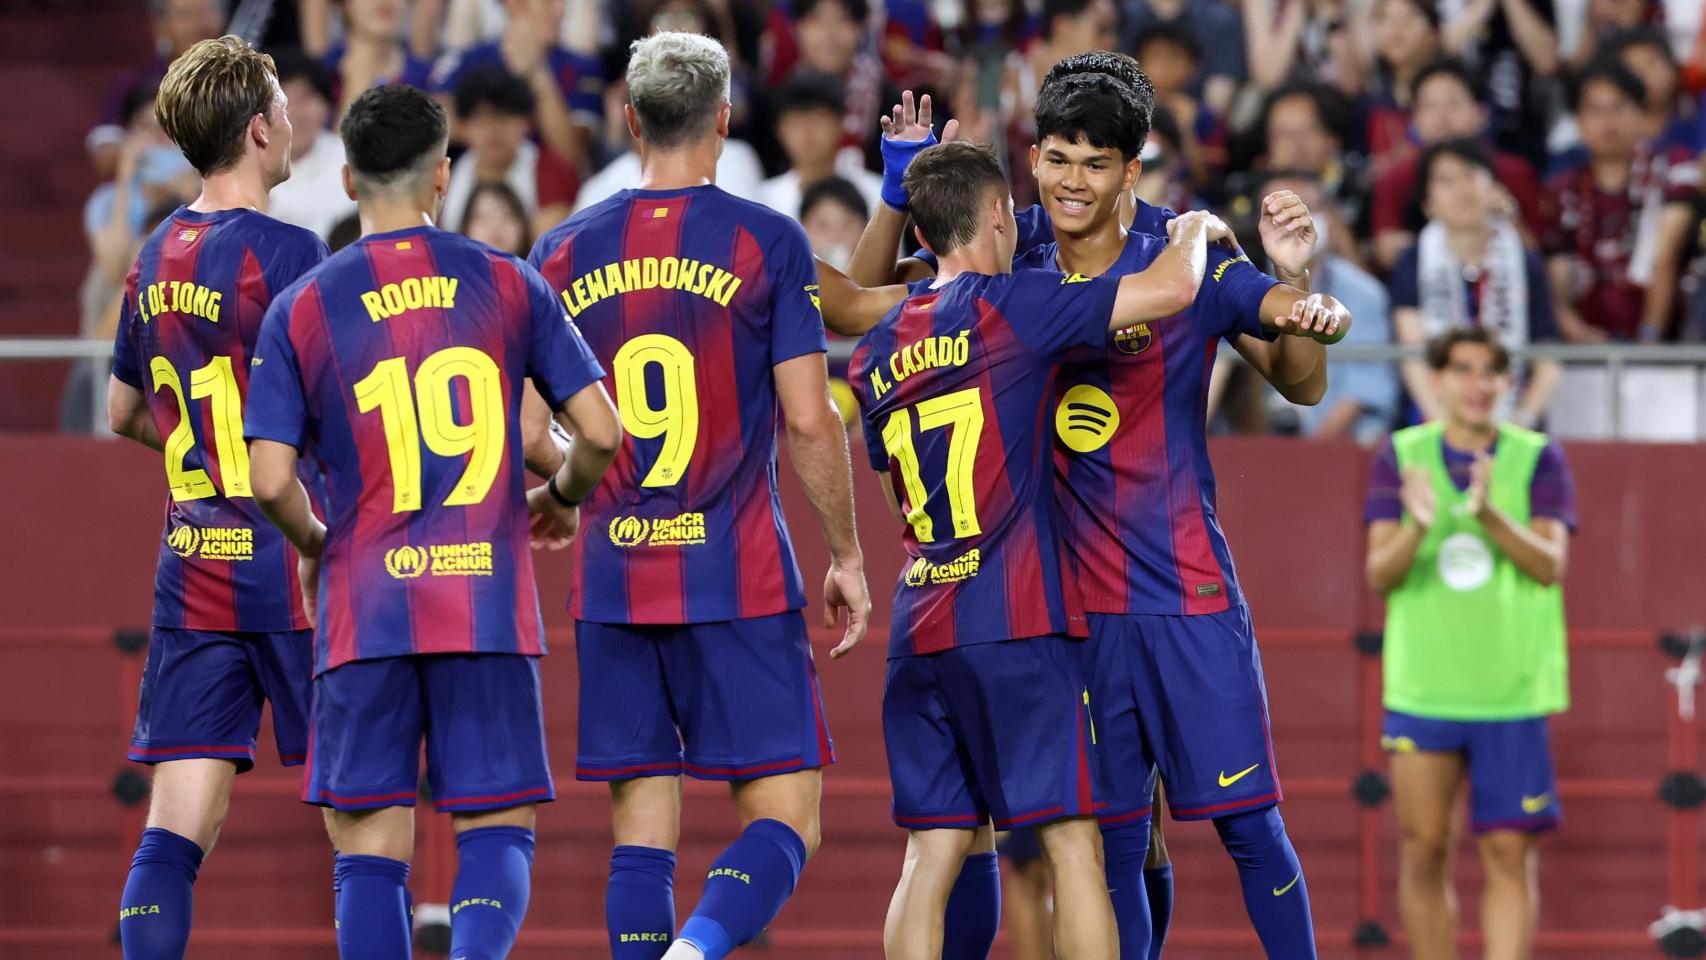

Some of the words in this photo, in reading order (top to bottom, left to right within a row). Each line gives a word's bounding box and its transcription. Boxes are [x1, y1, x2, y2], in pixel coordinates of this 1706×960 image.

[147, 281, 169, 316] DE
[169, 281, 222, 323] JONG
[360, 276, 458, 323] ROONY
[561, 256, 743, 318] LEWANDOWSKI
[889, 329, 971, 382] CASADÓ
[150, 356, 254, 502] 21
[353, 346, 505, 514] 19
[612, 333, 699, 487] 9
[881, 387, 984, 543] 17
[200, 541, 253, 554] ACNUR
[201, 528, 253, 541] UNHCR
[429, 542, 492, 558] UNHCR
[648, 525, 706, 541] ACNUR
[430, 555, 493, 570] ACNUR
[930, 561, 979, 579] ACNUR
[620, 933, 668, 943] BARÇA
